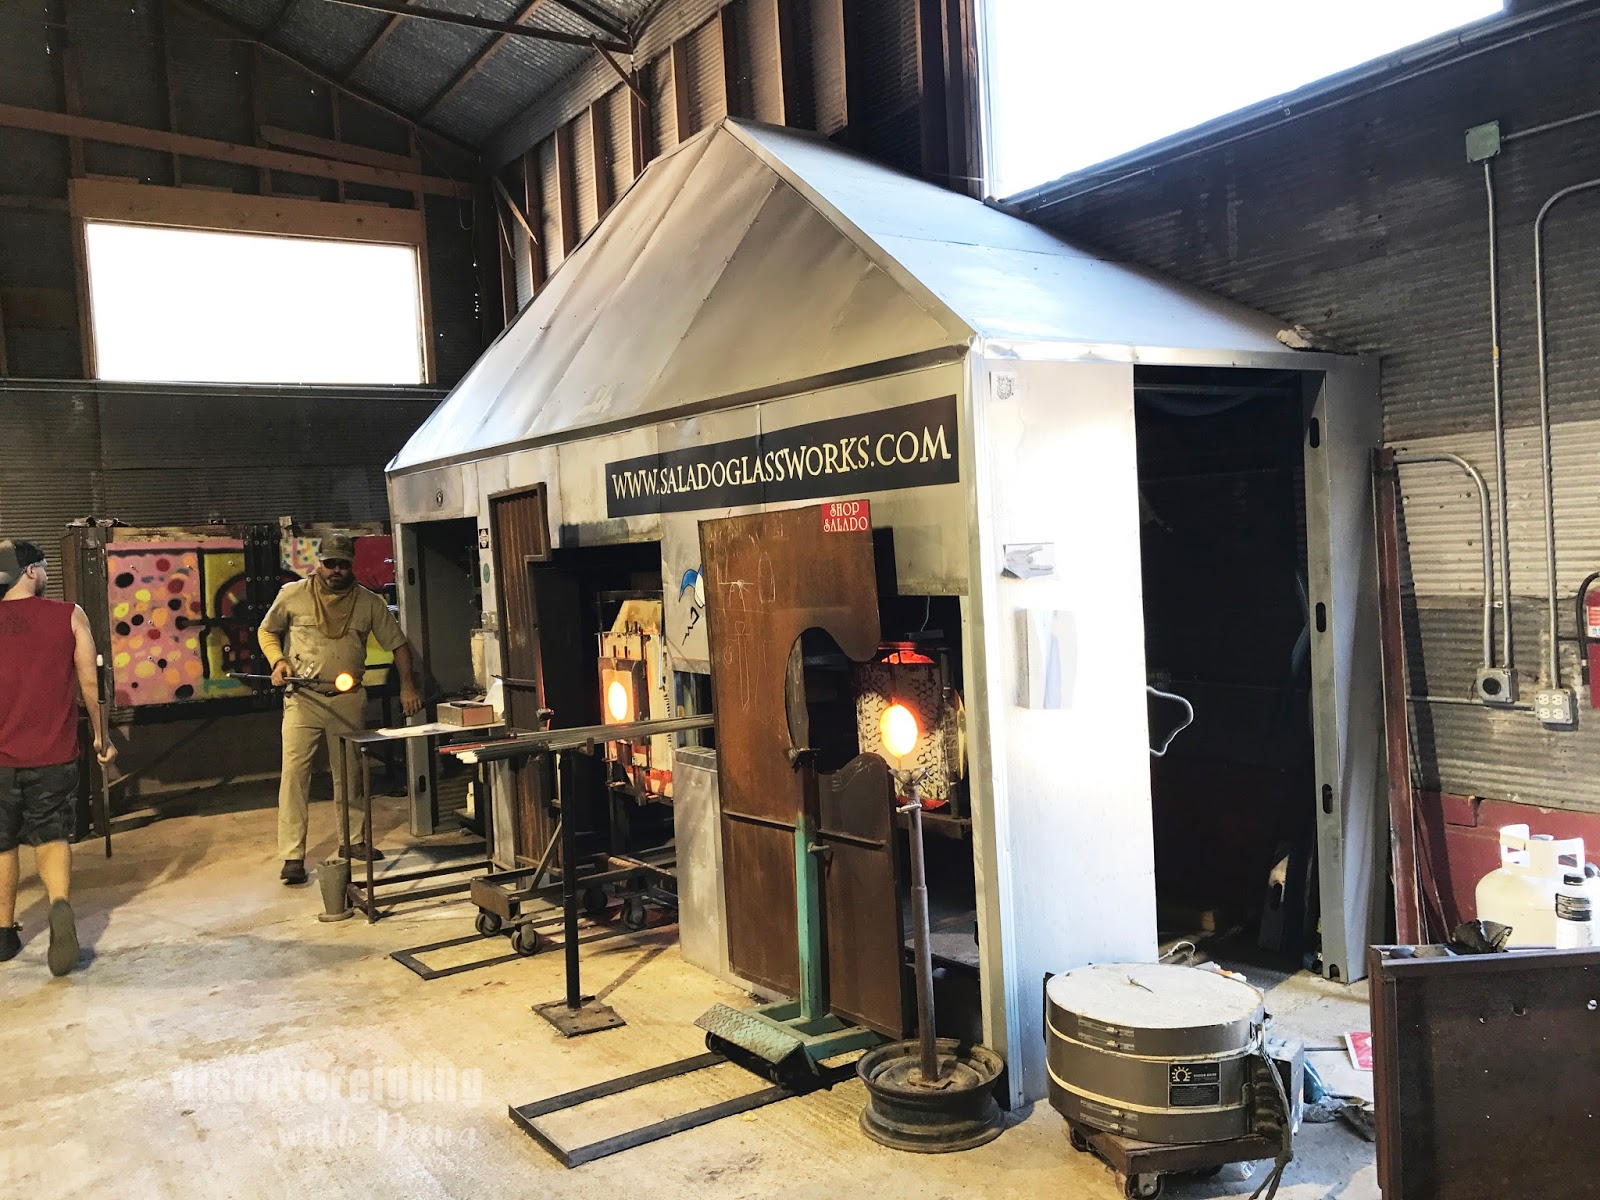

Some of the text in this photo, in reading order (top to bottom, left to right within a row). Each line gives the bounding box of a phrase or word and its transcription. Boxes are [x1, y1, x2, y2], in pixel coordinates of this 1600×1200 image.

[611, 424, 952, 500] WWW.SALADOGLASSWORKS.COM
[829, 502, 860, 517] SHOP
[823, 516, 868, 532] SALADO
